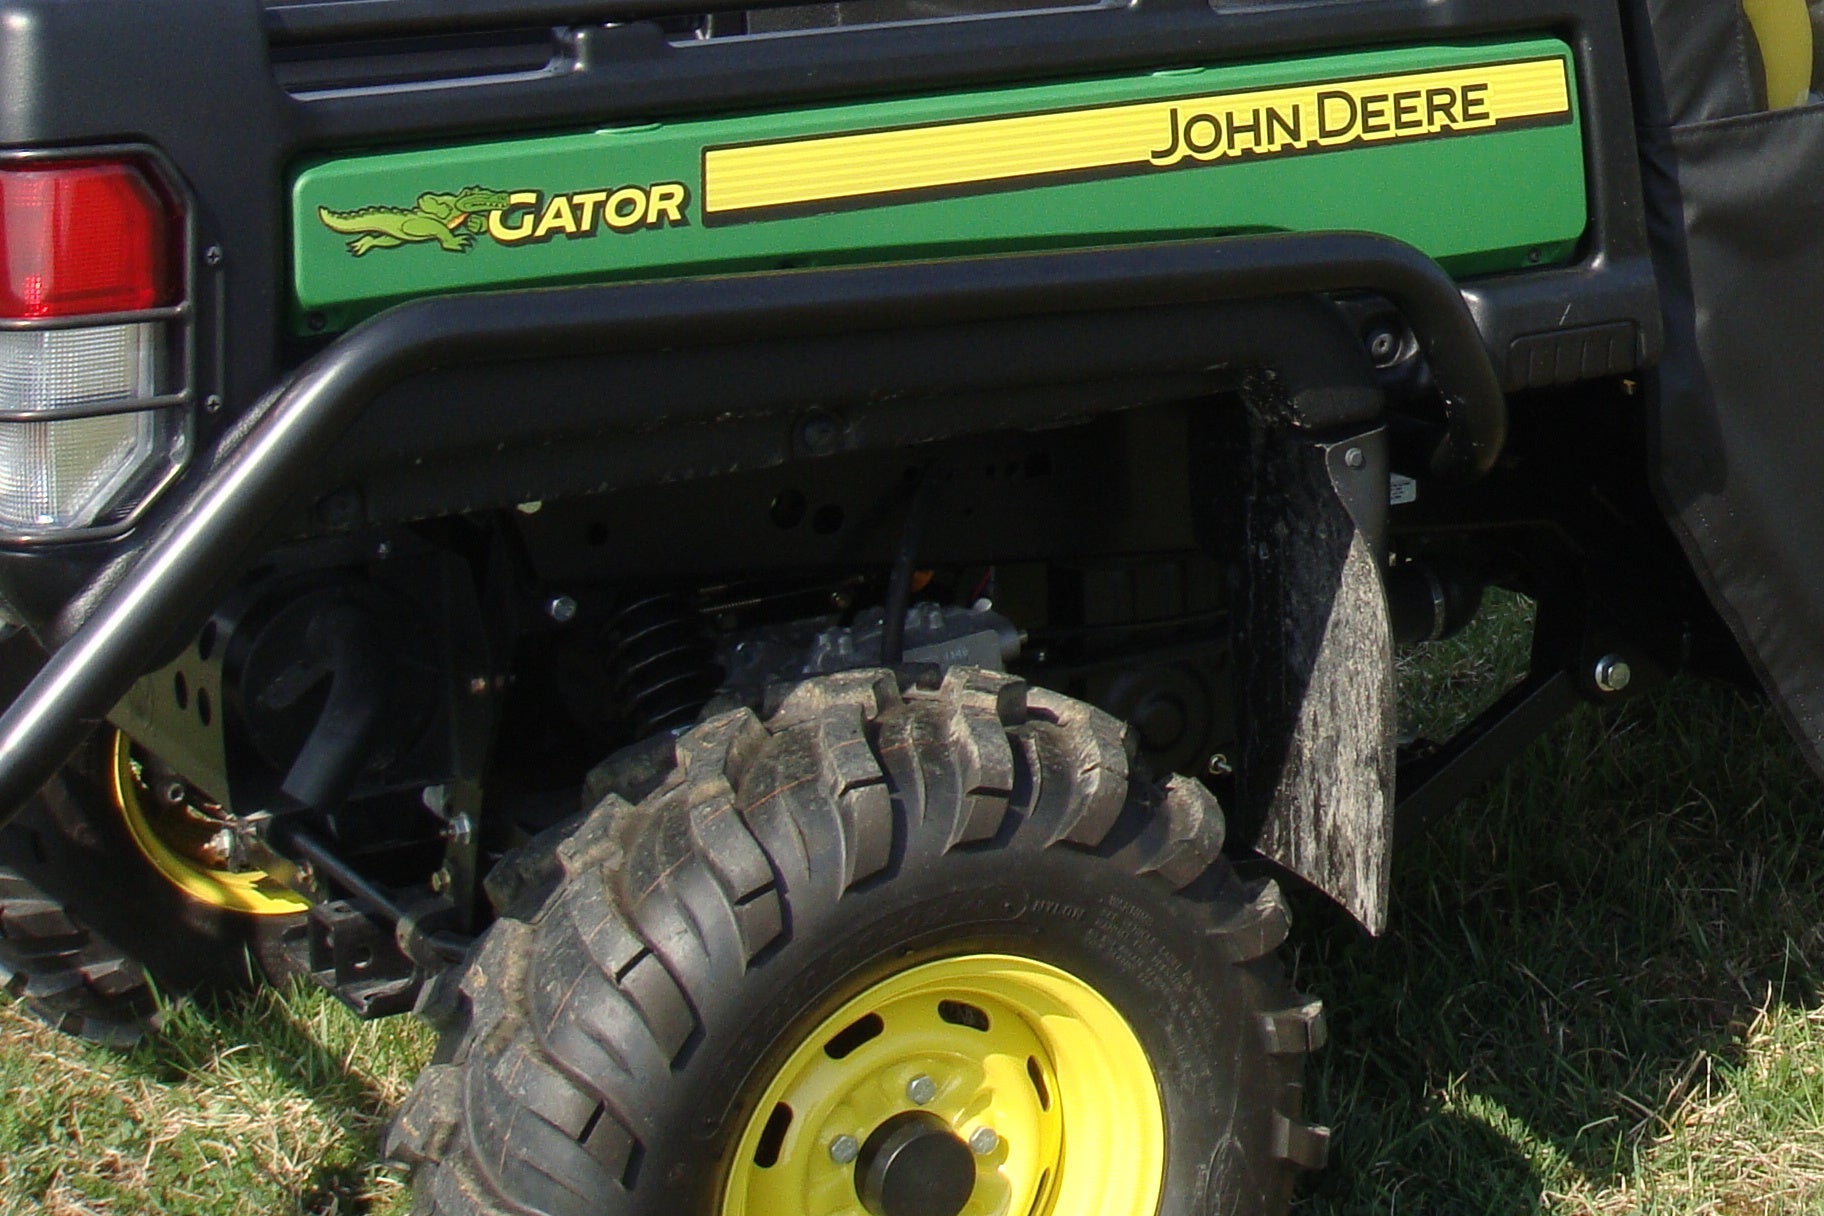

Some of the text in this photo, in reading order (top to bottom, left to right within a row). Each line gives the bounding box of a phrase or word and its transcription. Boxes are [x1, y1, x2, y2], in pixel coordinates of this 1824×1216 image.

[1150, 83, 1491, 160] JOHN DEERE
[488, 181, 690, 247] GATOR
[1032, 899, 1086, 921] NYLON
